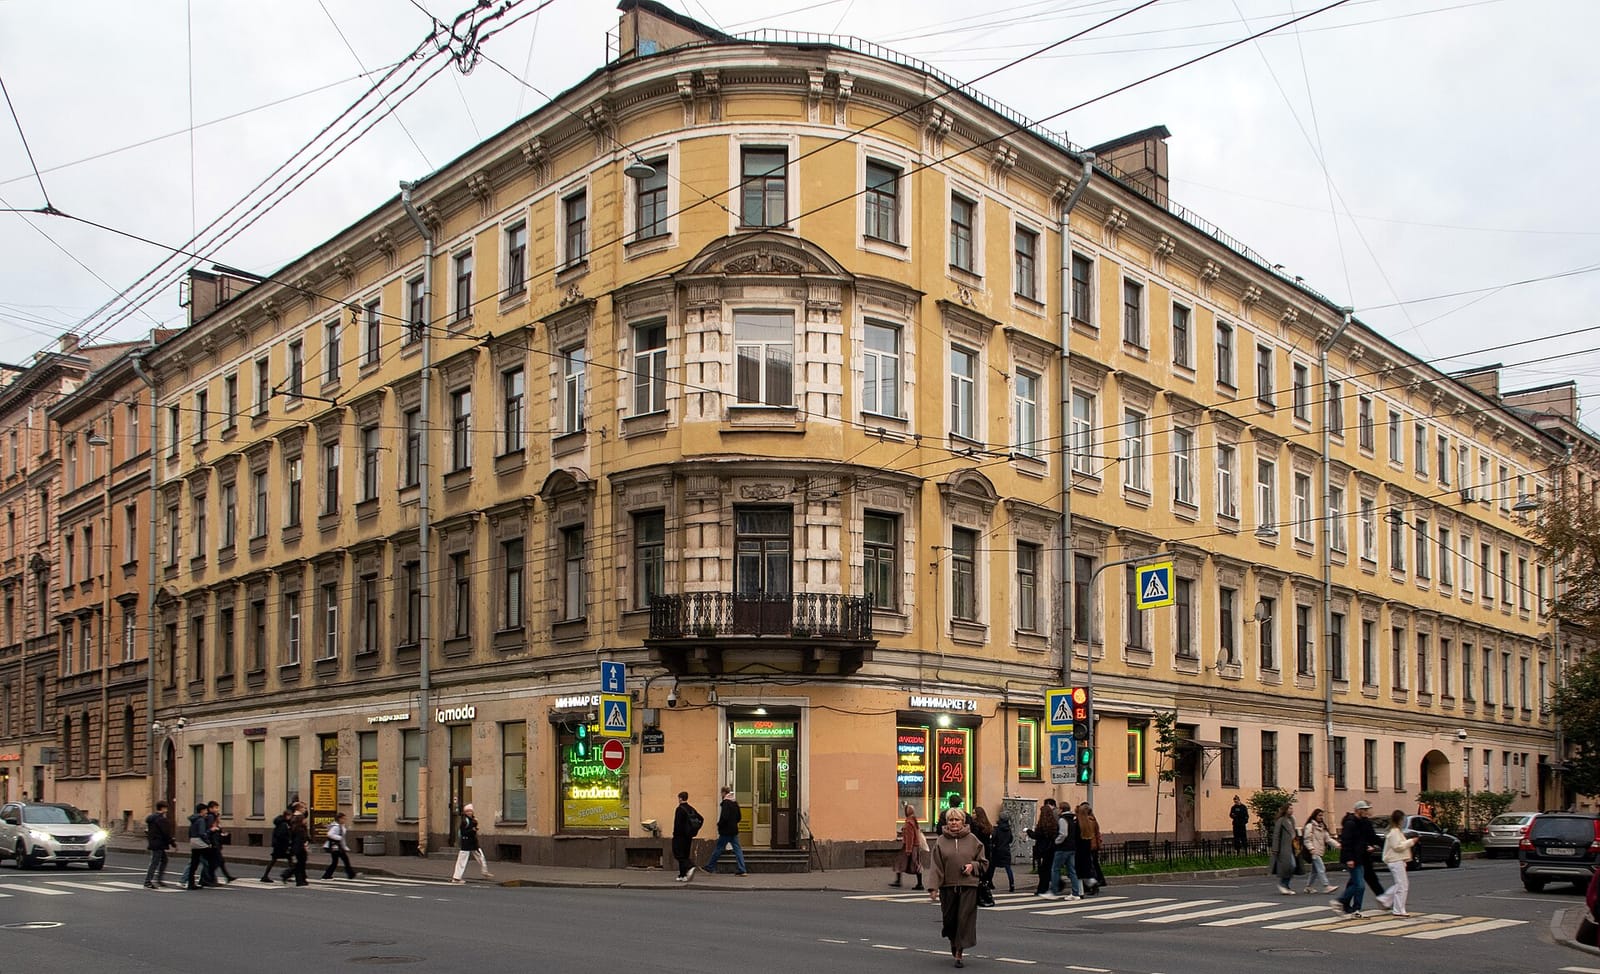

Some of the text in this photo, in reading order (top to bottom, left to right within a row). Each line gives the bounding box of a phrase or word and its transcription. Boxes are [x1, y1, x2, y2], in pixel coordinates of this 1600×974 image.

[911, 696, 977, 711] МИНИМАРКЕТ 24
[435, 704, 475, 723] lamoda
[573, 765, 606, 776] ПОДАРКИ
[942, 762, 963, 782] 24
[578, 806, 603, 817] SECOND
